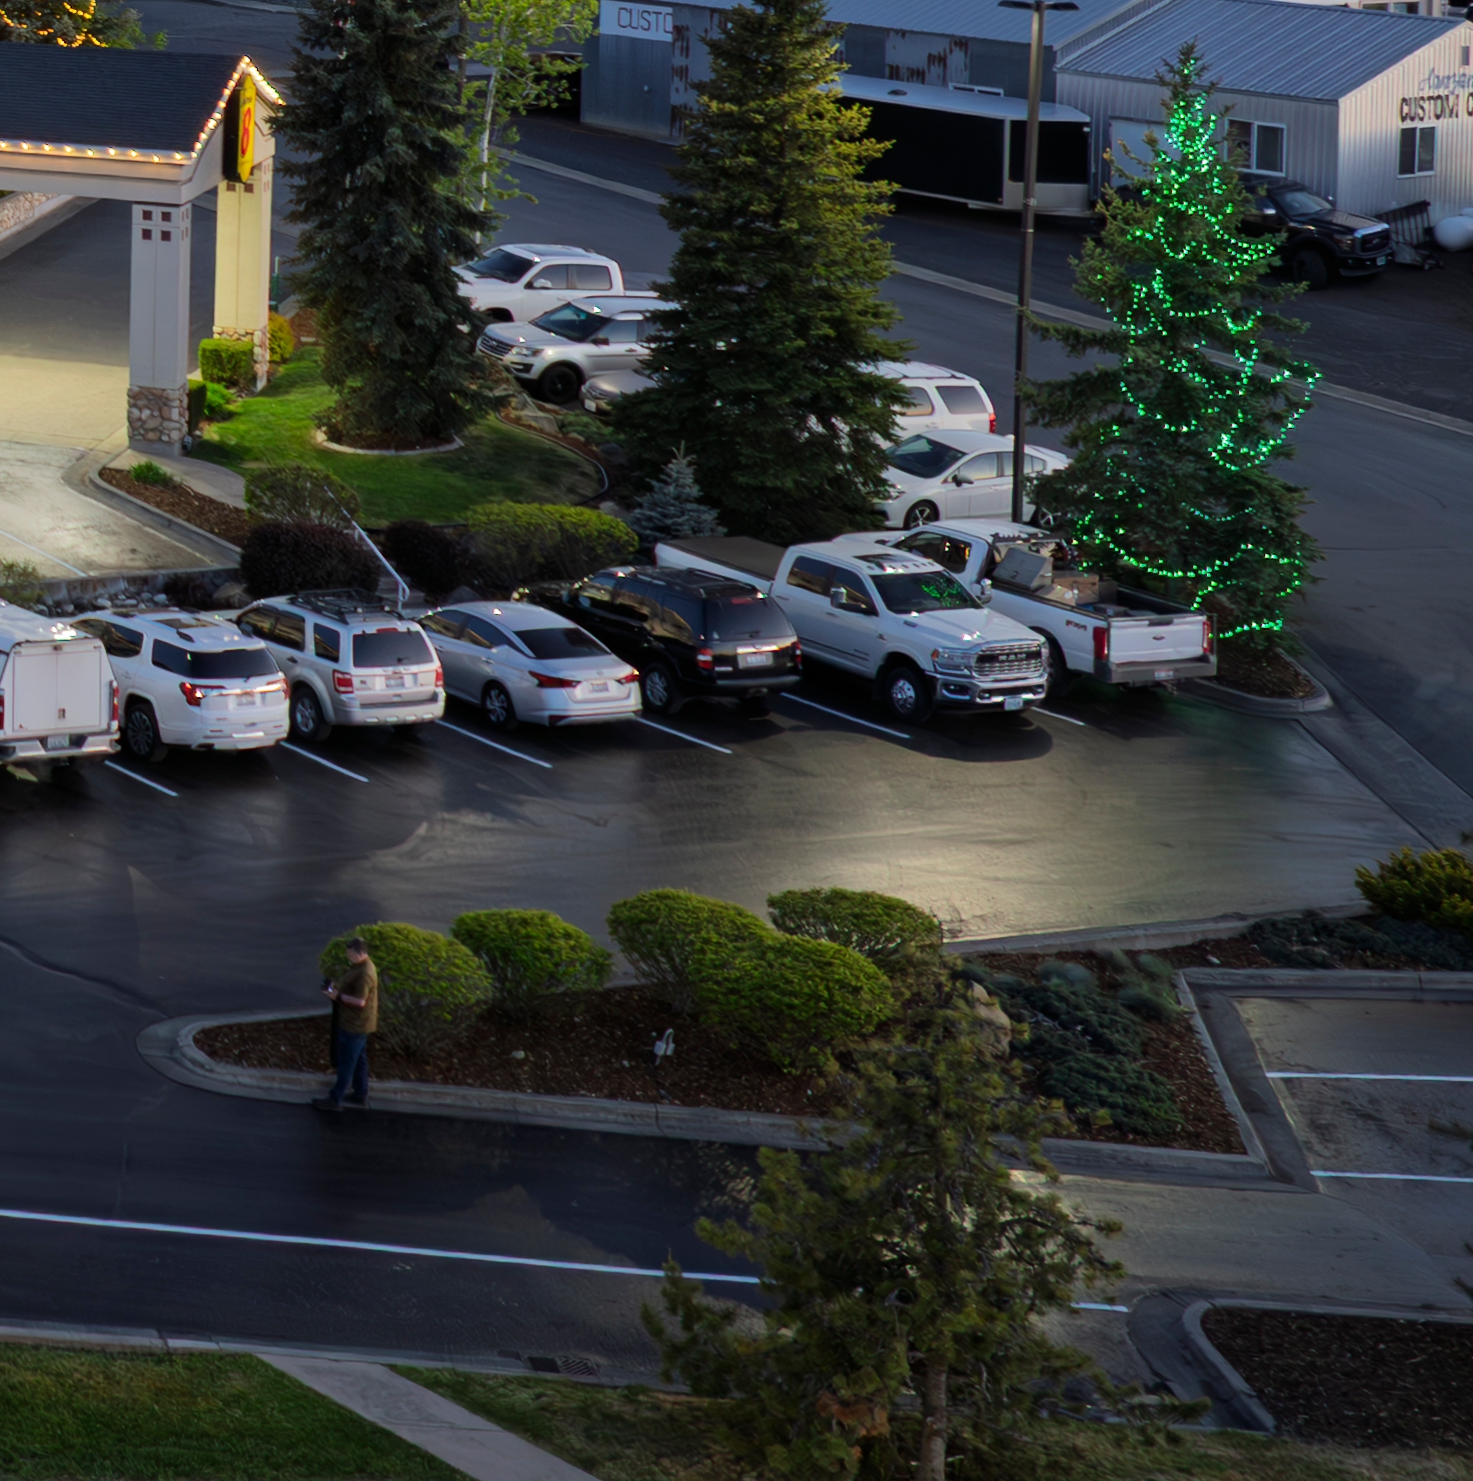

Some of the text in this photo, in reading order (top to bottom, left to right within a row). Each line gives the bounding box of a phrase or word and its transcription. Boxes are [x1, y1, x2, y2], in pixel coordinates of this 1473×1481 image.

[1400, 94, 1459, 122] CUSTOM
[240, 106, 252, 159] 8
[998, 653, 1027, 661] RAM
